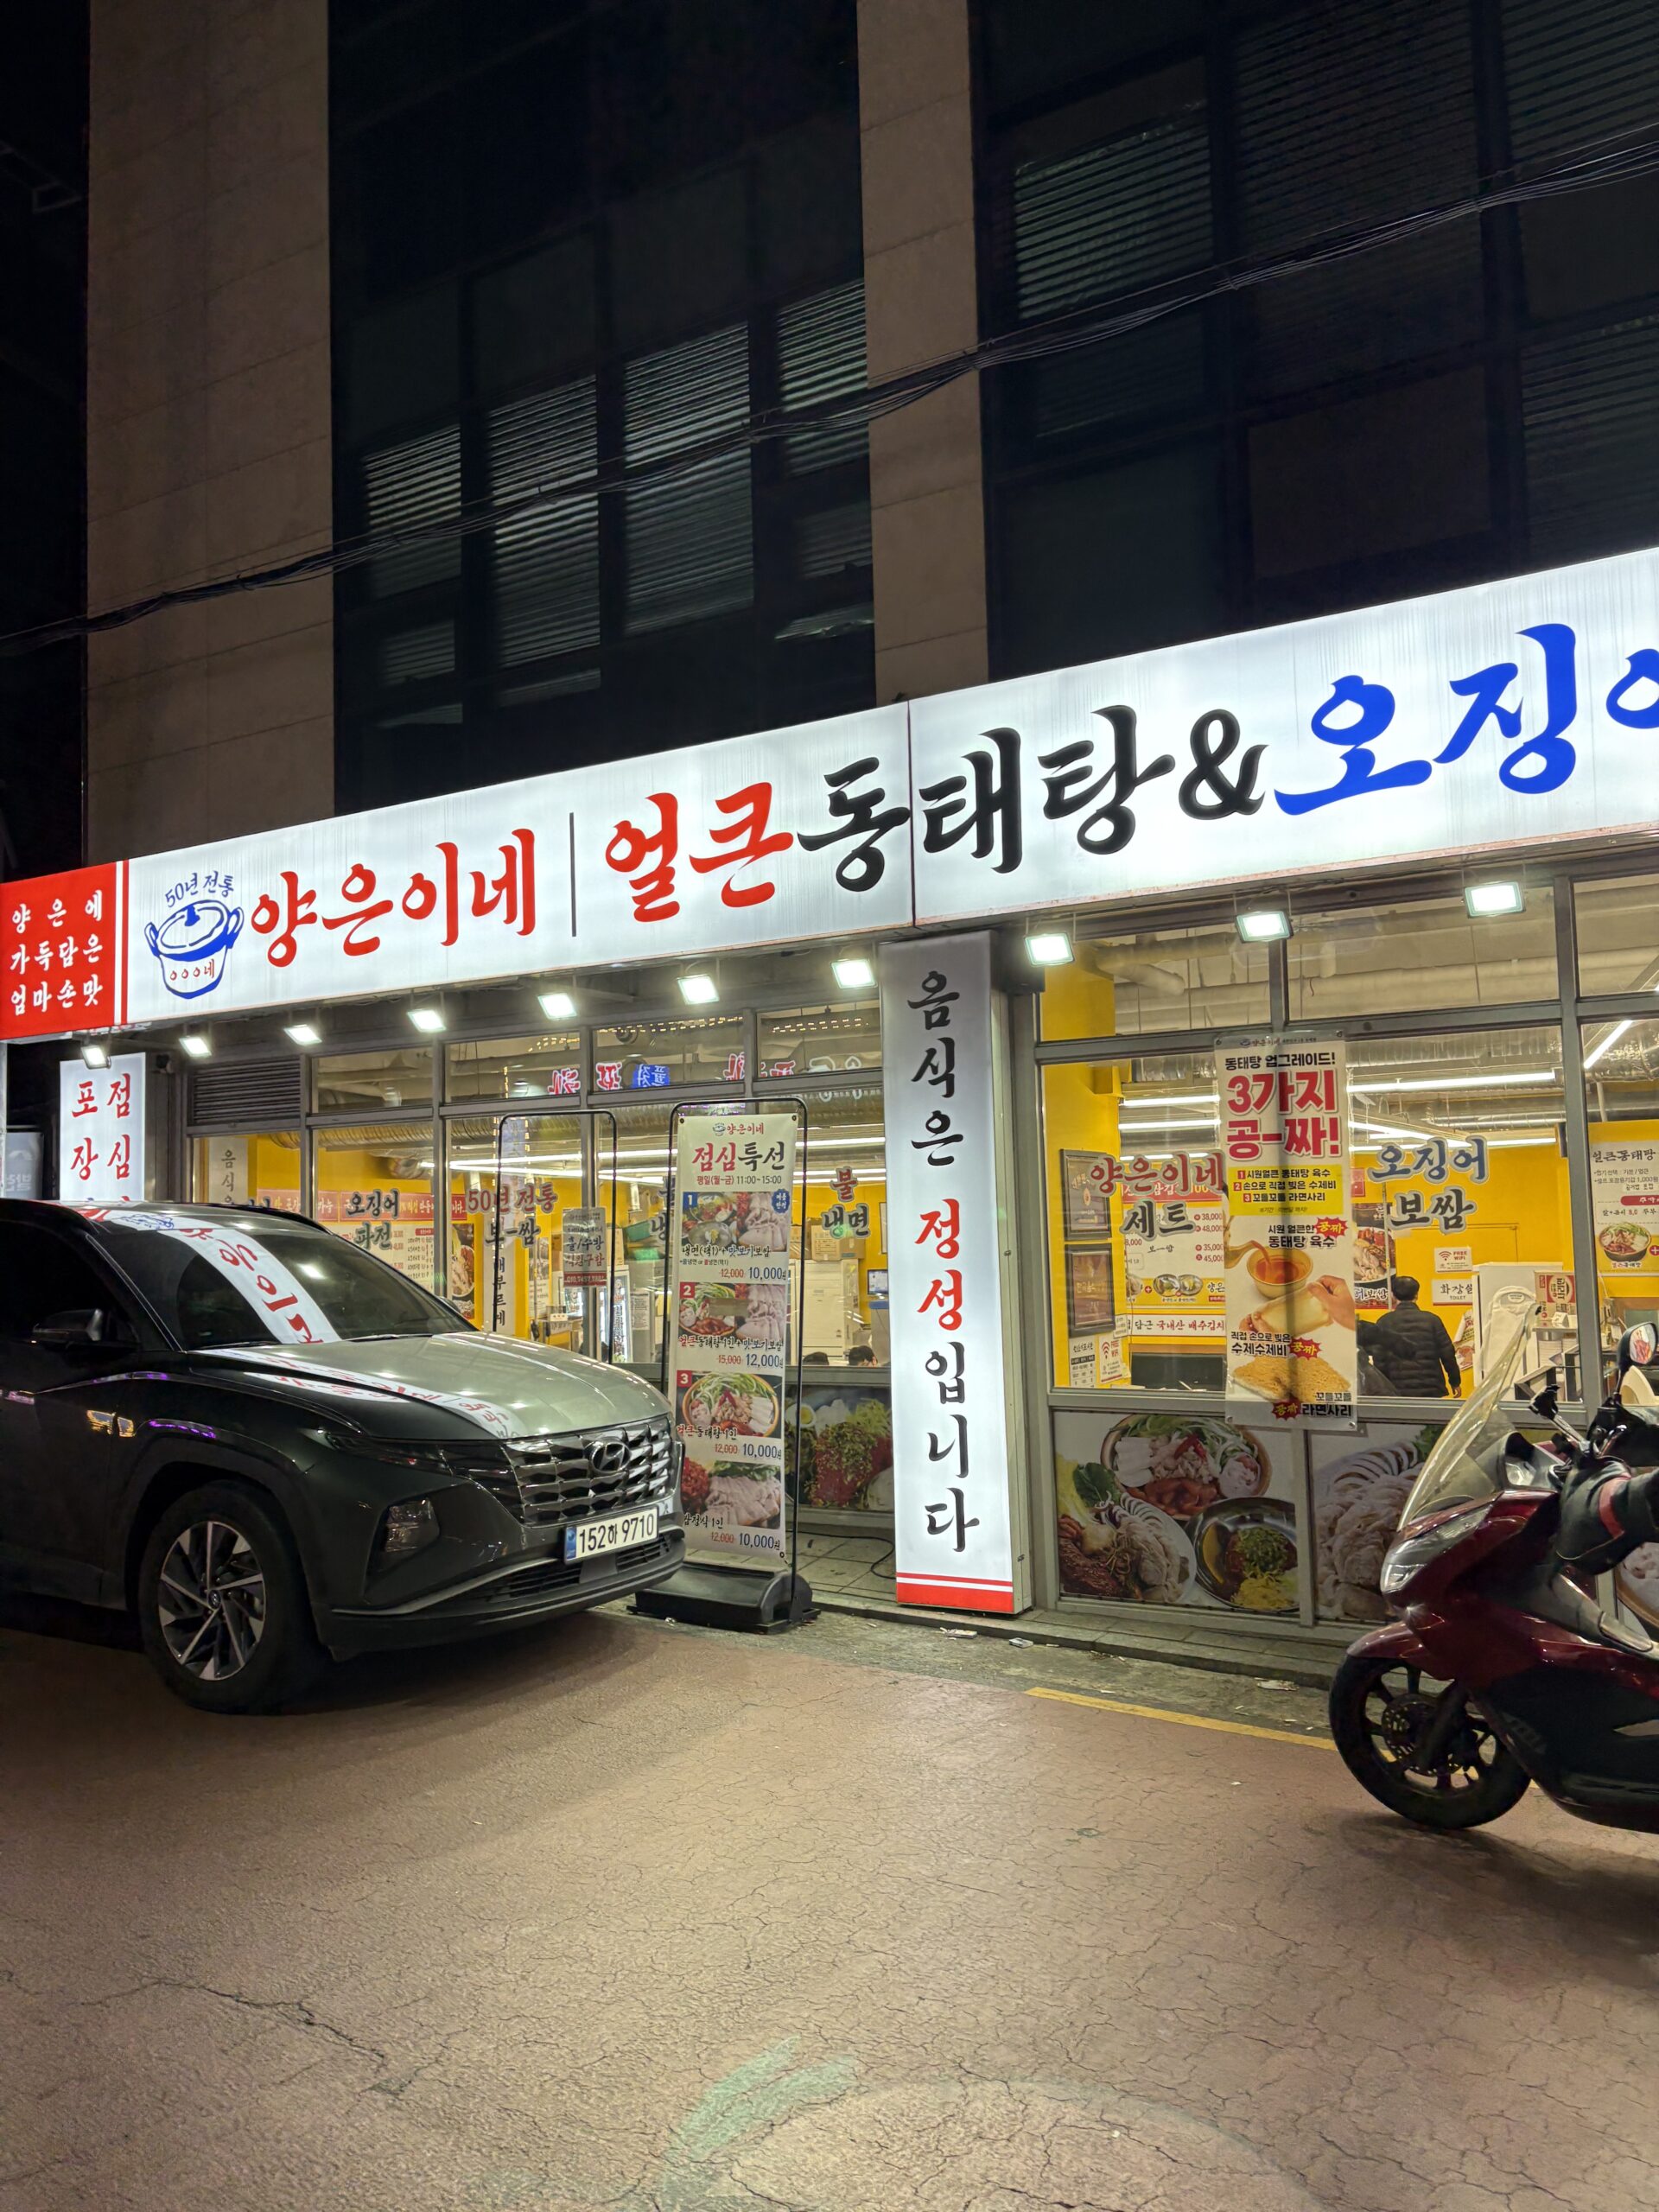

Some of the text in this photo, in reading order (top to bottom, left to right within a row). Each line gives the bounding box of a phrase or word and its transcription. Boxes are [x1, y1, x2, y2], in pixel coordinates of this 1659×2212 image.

[165, 870, 234, 907] 50년 전통
[251, 827, 536, 968] 양은이네
[10, 933, 103, 975] 가득담은
[11, 974, 103, 1016] 엄마손맛
[907, 970, 964, 1166] 음식은
[1225, 1052, 1336, 1071] 동태탕 업그레이드!
[1227, 1070, 1337, 1115] 3가지
[726, 1122, 765, 1135] 양은이네
[691, 1141, 785, 1173] 점심특선
[1372, 1138, 1486, 1180] 오징어
[1592, 1148, 1656, 1163] 얼큰동태탕
[696, 1174, 782, 1186] 평일(월~금) 11:00~15:00
[1090, 1152, 1224, 1194] 양은이네
[1282, 1168, 1309, 1179] 동태탕
[1313, 1168, 1331, 1179] 육수
[831, 1168, 858, 1200] 불
[1243, 1181, 1267, 1191] 손으로
[1268, 1180, 1286, 1191] 직접
[1309, 1179, 1337, 1190] 수제비
[346, 1188, 399, 1218] 오징어
[468, 1182, 558, 1213] 50년 전통
[688, 1194, 693, 1205] 1
[1288, 1192, 1325, 1202] 라면사리
[1391, 1188, 1475, 1230] 보쌈
[824, 1205, 869, 1236] 냉면
[1123, 1200, 1193, 1238] 세트
[355, 1222, 392, 1249] 파전
[1268, 1224, 1285, 1235] 시원
[1317, 1221, 1343, 1236] 공짜
[1268, 1235, 1336, 1249] 동태탕 육수
[719, 1268, 744, 1279] 12,000
[683, 1285, 691, 1296] 2
[1156, 1320, 1185, 1331] 국내산
[1230, 1332, 1247, 1341] 직접
[1249, 1332, 1273, 1342] 손으로
[1231, 1341, 1318, 1357] 수제수제비 공짜
[717, 1354, 741, 1365] 15,000
[681, 1374, 690, 1384] 3
[914, 1198, 980, 1553] 정성입니다
[1316, 1391, 1352, 1402] 꼬들꼬들
[1274, 1402, 1352, 1416] 공짜 라면사리
[724, 1427, 738, 1440] 1인
[715, 1443, 738, 1455] 12,000
[712, 1516, 724, 1529] 1인
[579, 1513, 654, 1554] 152하 9710
[711, 1531, 734, 1543] 12,000
